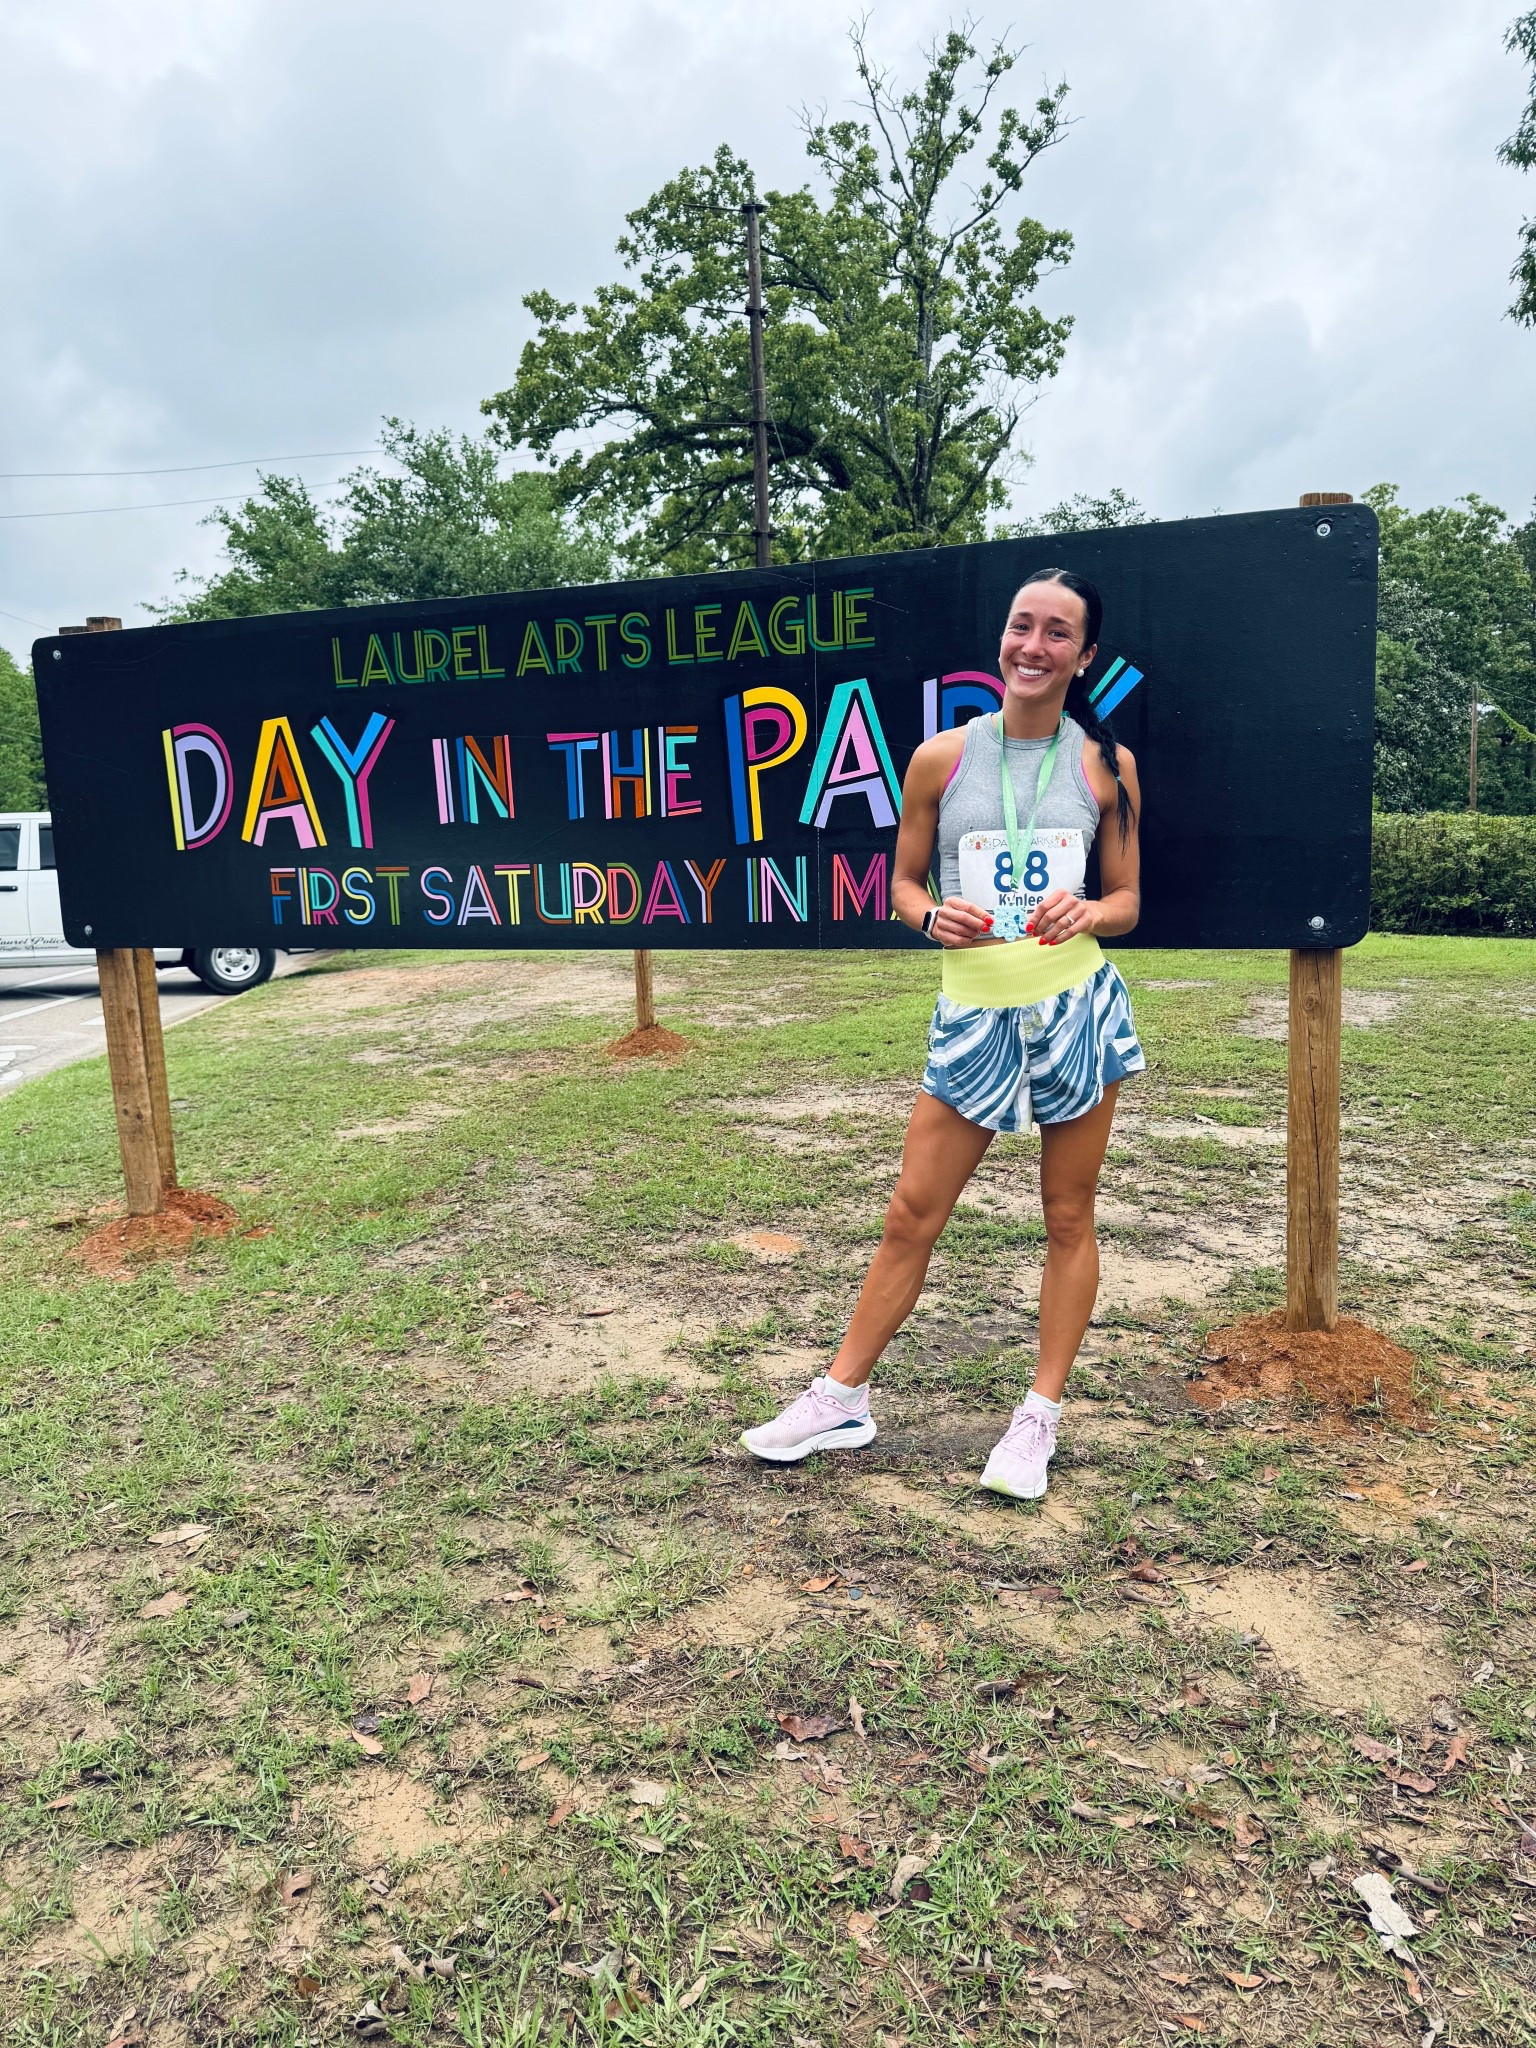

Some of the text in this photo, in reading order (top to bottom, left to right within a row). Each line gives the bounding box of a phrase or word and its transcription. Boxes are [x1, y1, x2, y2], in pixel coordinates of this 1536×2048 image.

[332, 587, 876, 689] LAUREL ARTS LEAGUE
[162, 712, 396, 851] DAY
[432, 734, 515, 825] IN
[546, 725, 702, 821] THE
[269, 866, 410, 926] FIRST
[420, 858, 727, 926] SATURDAY
[746, 855, 808, 923] IN
[993, 850, 1049, 892] 88
